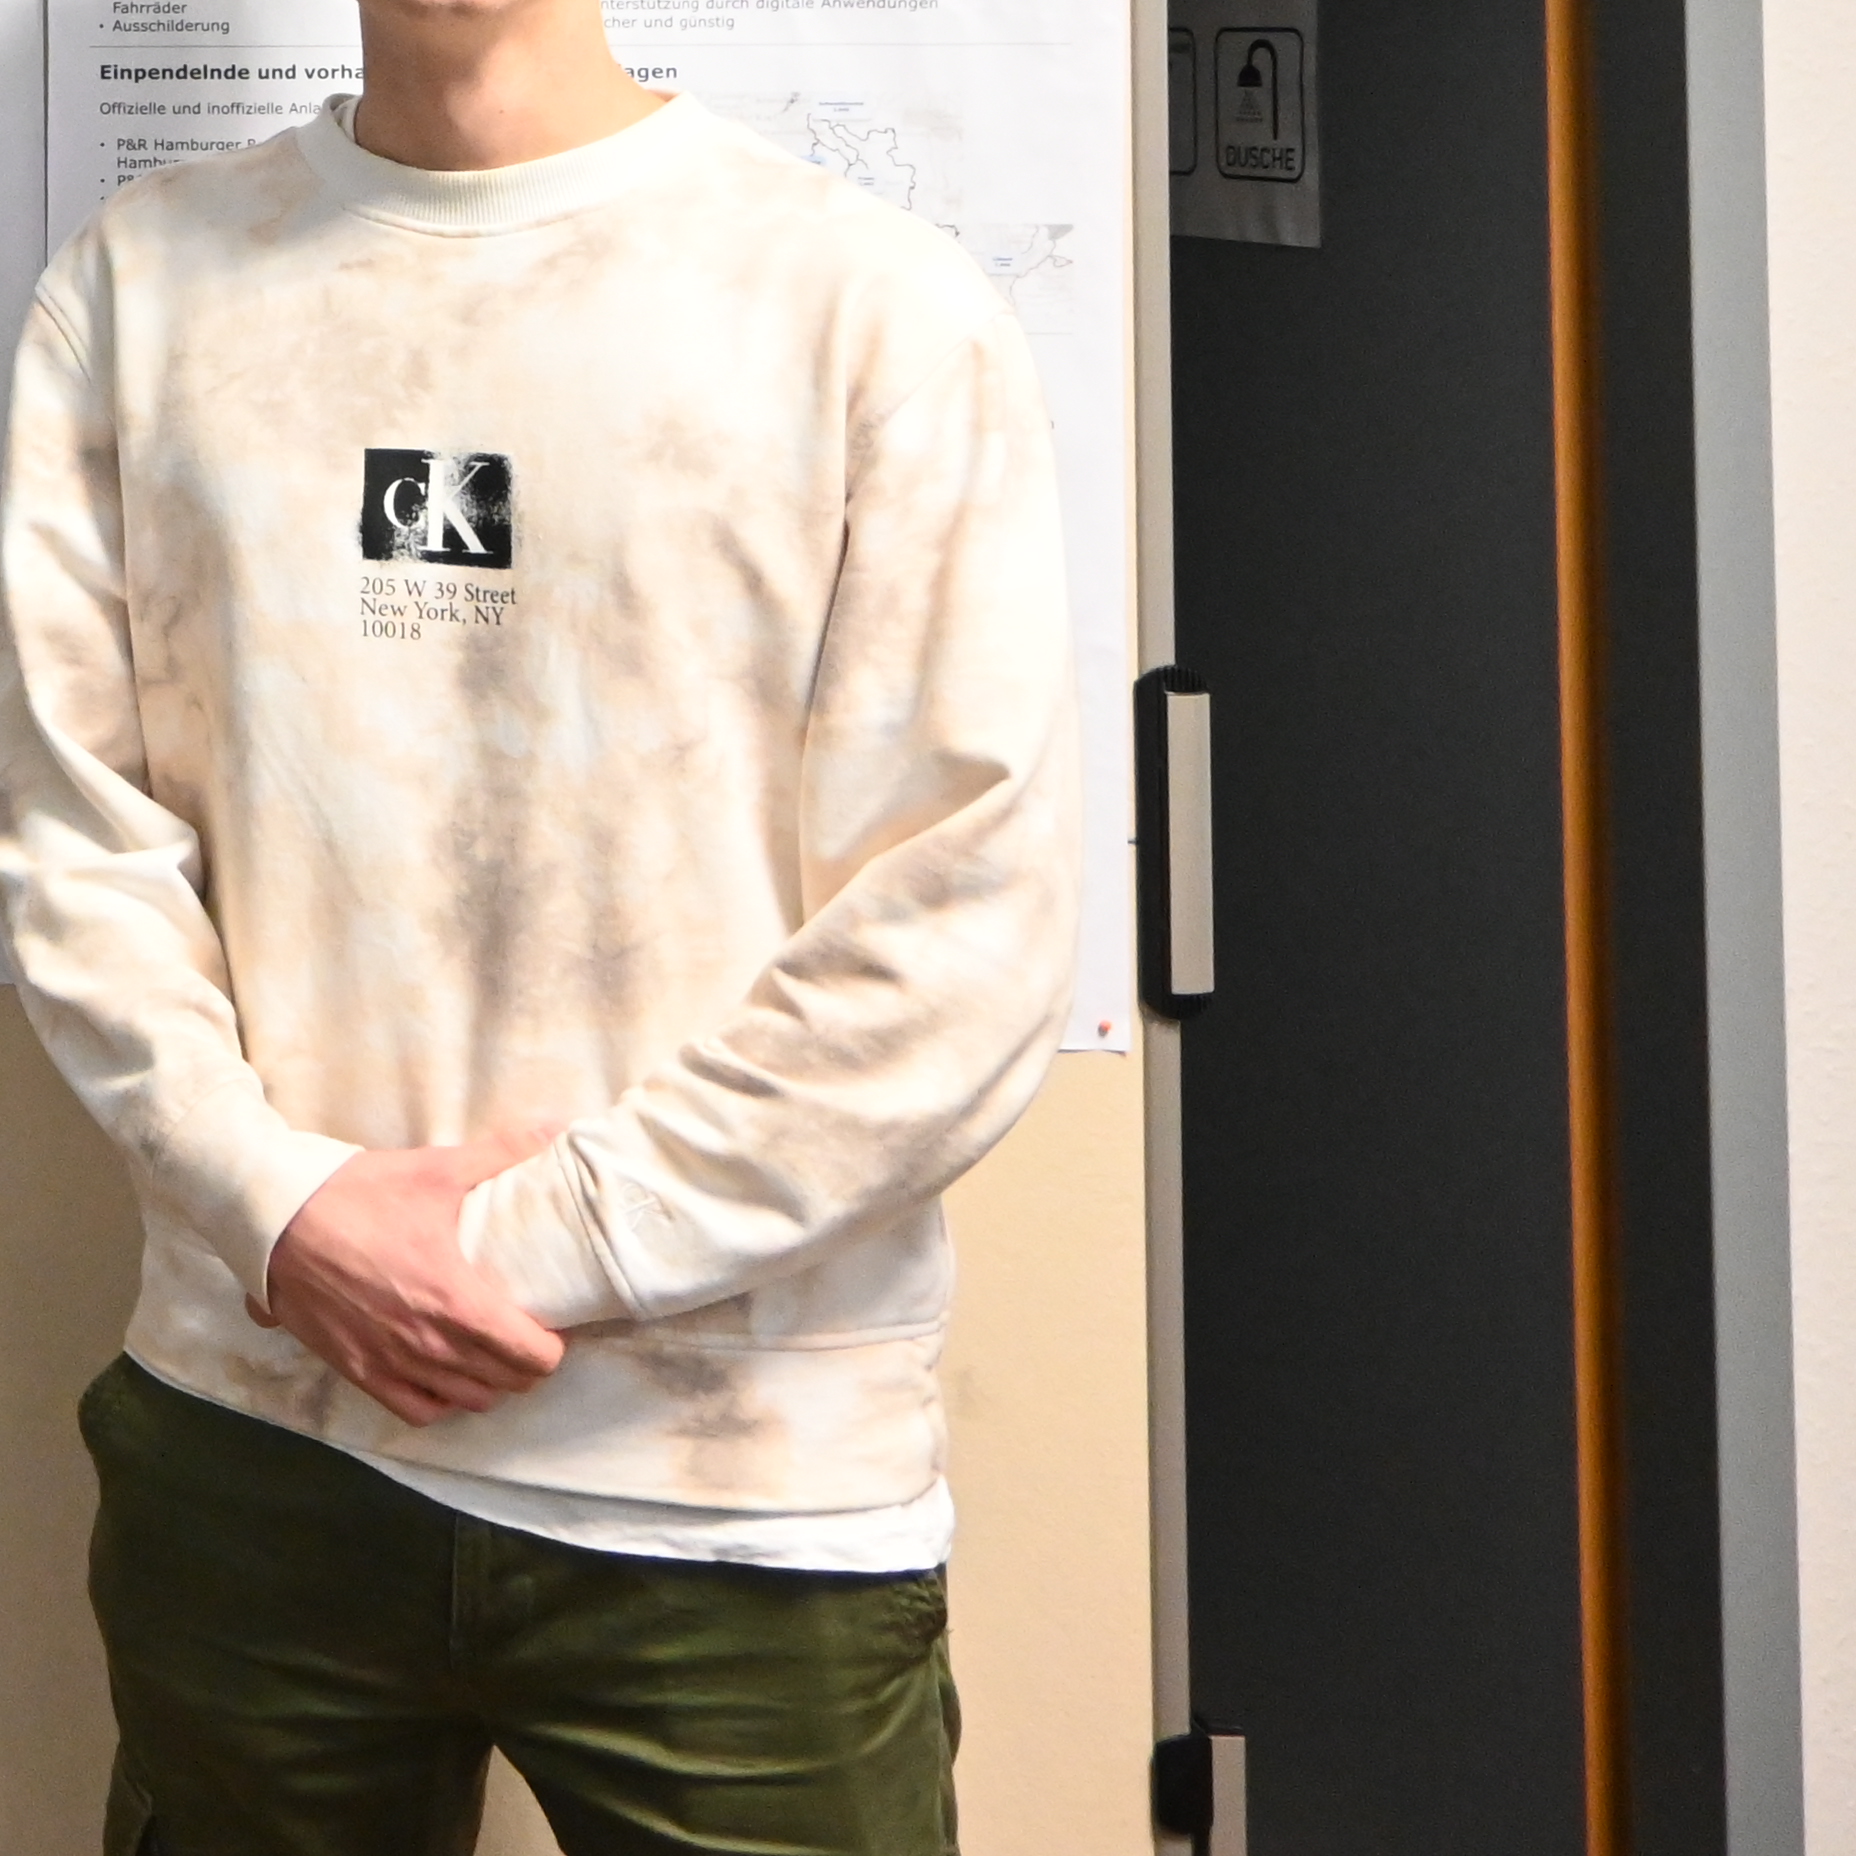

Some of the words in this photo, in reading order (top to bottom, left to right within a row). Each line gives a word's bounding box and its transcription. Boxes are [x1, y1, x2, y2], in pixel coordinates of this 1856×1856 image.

[112, 1, 188, 14] Fahrräder
[111, 18, 230, 35] Ausschilderung
[643, 15, 673, 28] und
[679, 16, 735, 31] günstig
[100, 63, 250, 83] Einpendelnde
[257, 63, 296, 80] und
[99, 101, 166, 115] Offizielle
[171, 101, 201, 115] und
[206, 101, 283, 115] inoffizielle
[116, 137, 148, 151] P&R
[1225, 145, 1296, 172] DUSCHE
[360, 576, 396, 596] 205
[404, 579, 428, 598] W
[434, 582, 458, 600] 39
[463, 584, 517, 605] Street
[360, 598, 406, 618] New
[414, 600, 467, 625] York,
[474, 606, 504, 626] NY
[361, 619, 422, 640] 10018
